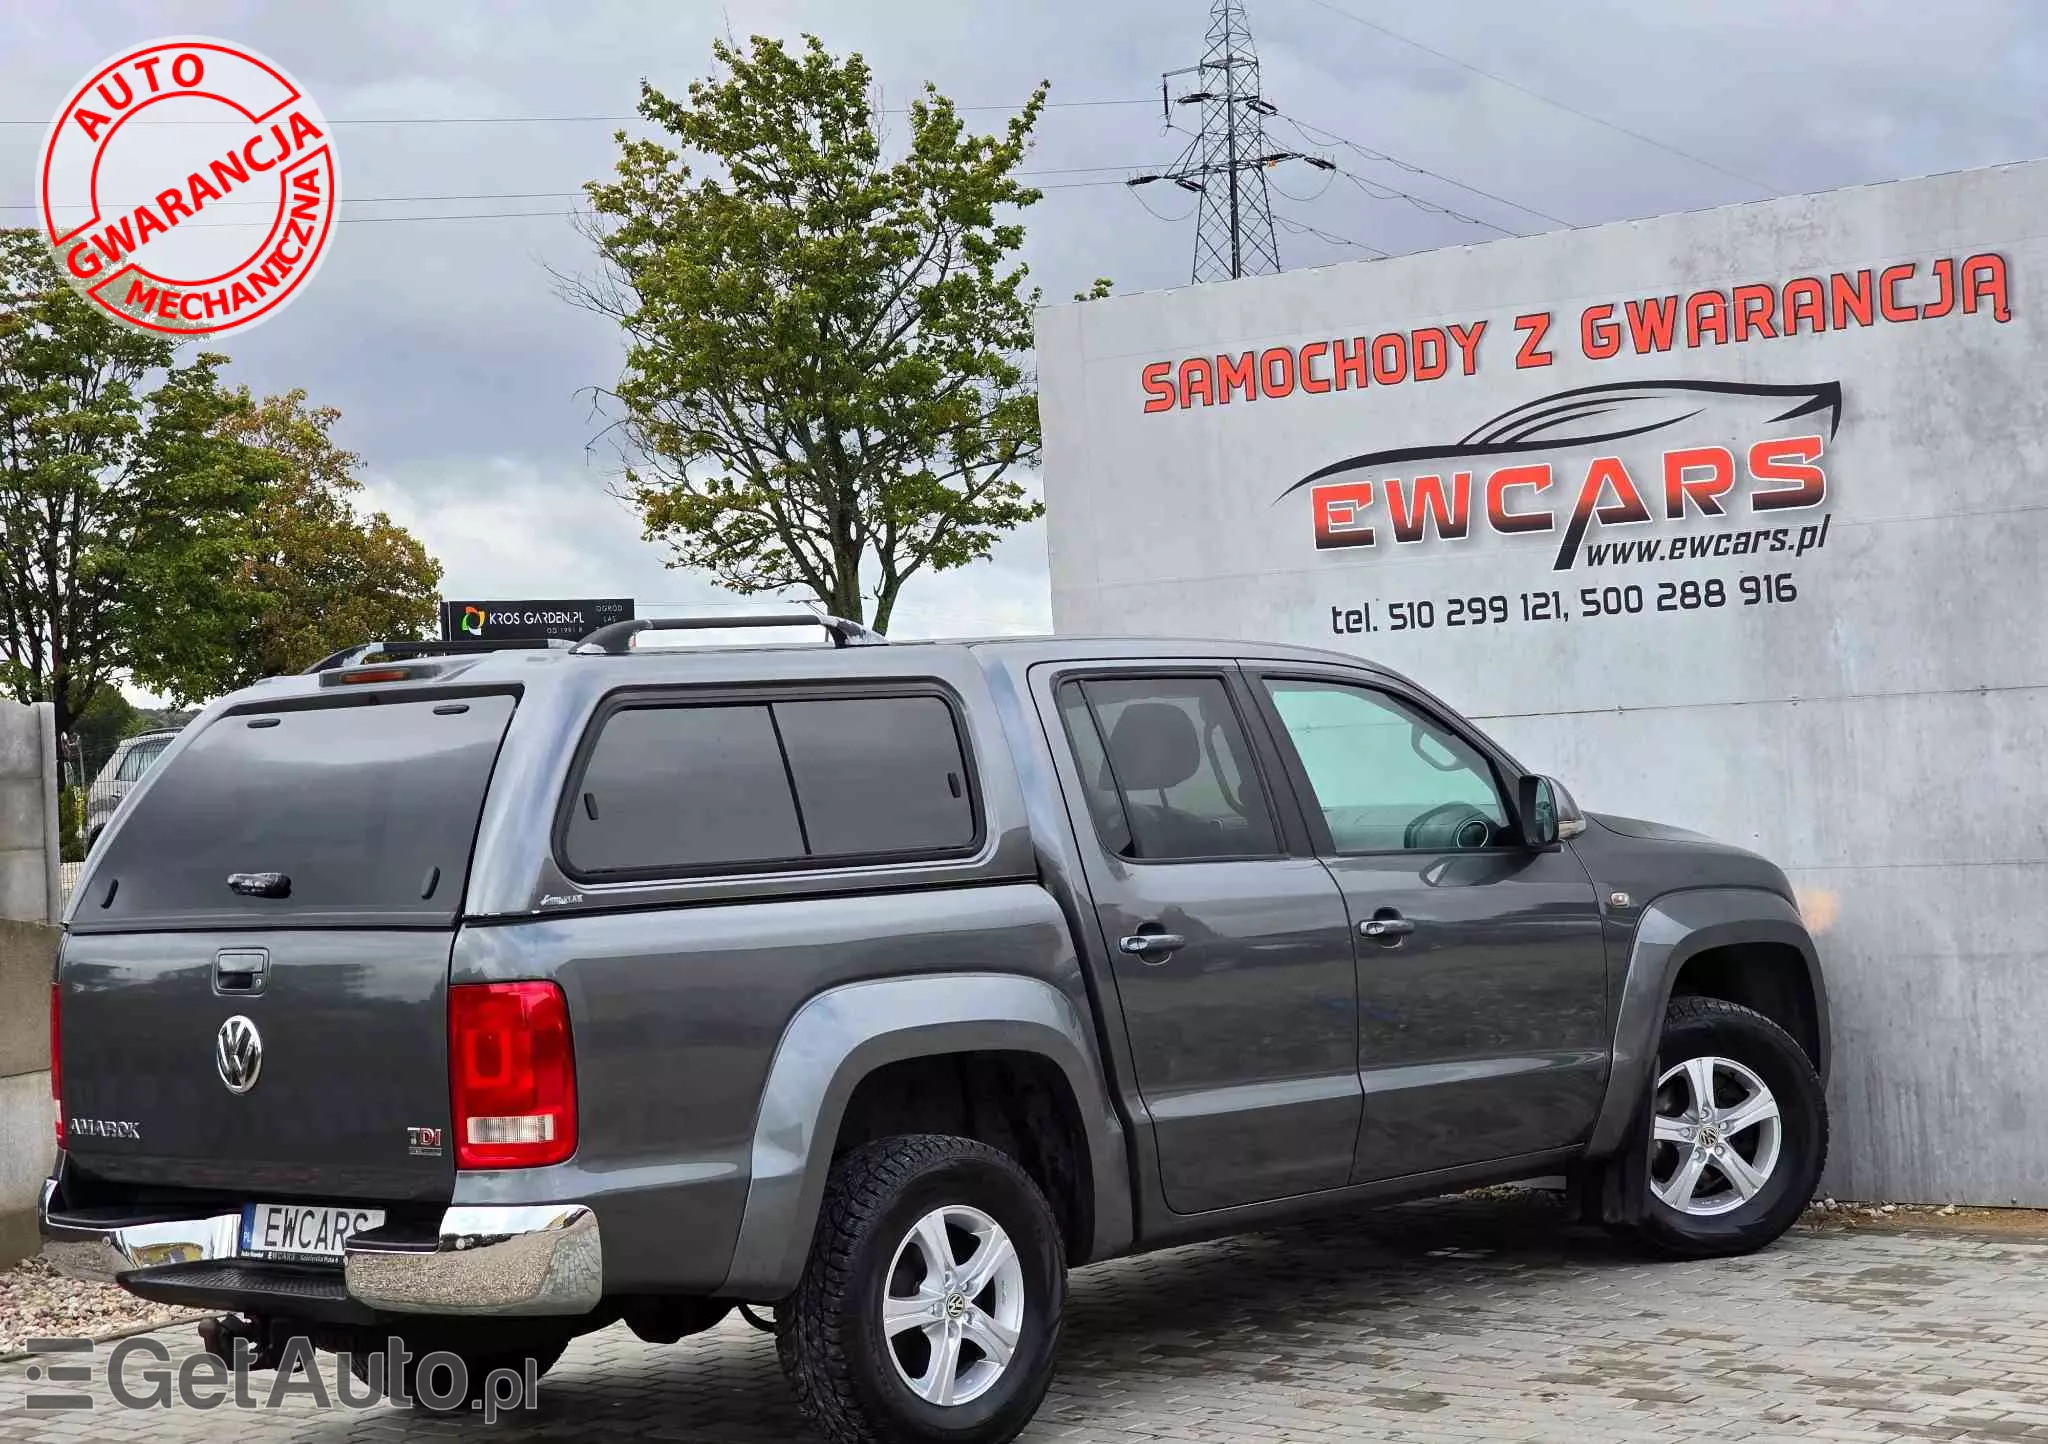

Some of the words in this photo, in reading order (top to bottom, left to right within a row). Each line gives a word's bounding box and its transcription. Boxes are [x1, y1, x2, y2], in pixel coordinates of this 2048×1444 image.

[1141, 319, 1489, 414] SAMOCHODY
[1513, 312, 1553, 369] Z
[1580, 252, 2013, 361] GWARANCJĄ
[1310, 434, 1828, 572] EWCARS
[1586, 513, 1832, 568] www.ewcars.pl
[489, 611, 520, 625] KROS
[523, 610, 585, 625] GARDEN.PL
[1332, 604, 1378, 635] tel.
[1389, 600, 1435, 631] 510
[1446, 595, 1509, 627] 299
[1520, 590, 1569, 623] 121,
[1581, 584, 1644, 617] 500
[1656, 577, 1727, 613] 288
[1738, 572, 1798, 606] 916
[71, 1117, 140, 1139] AMAROK
[407, 1126, 442, 1146] TDI
